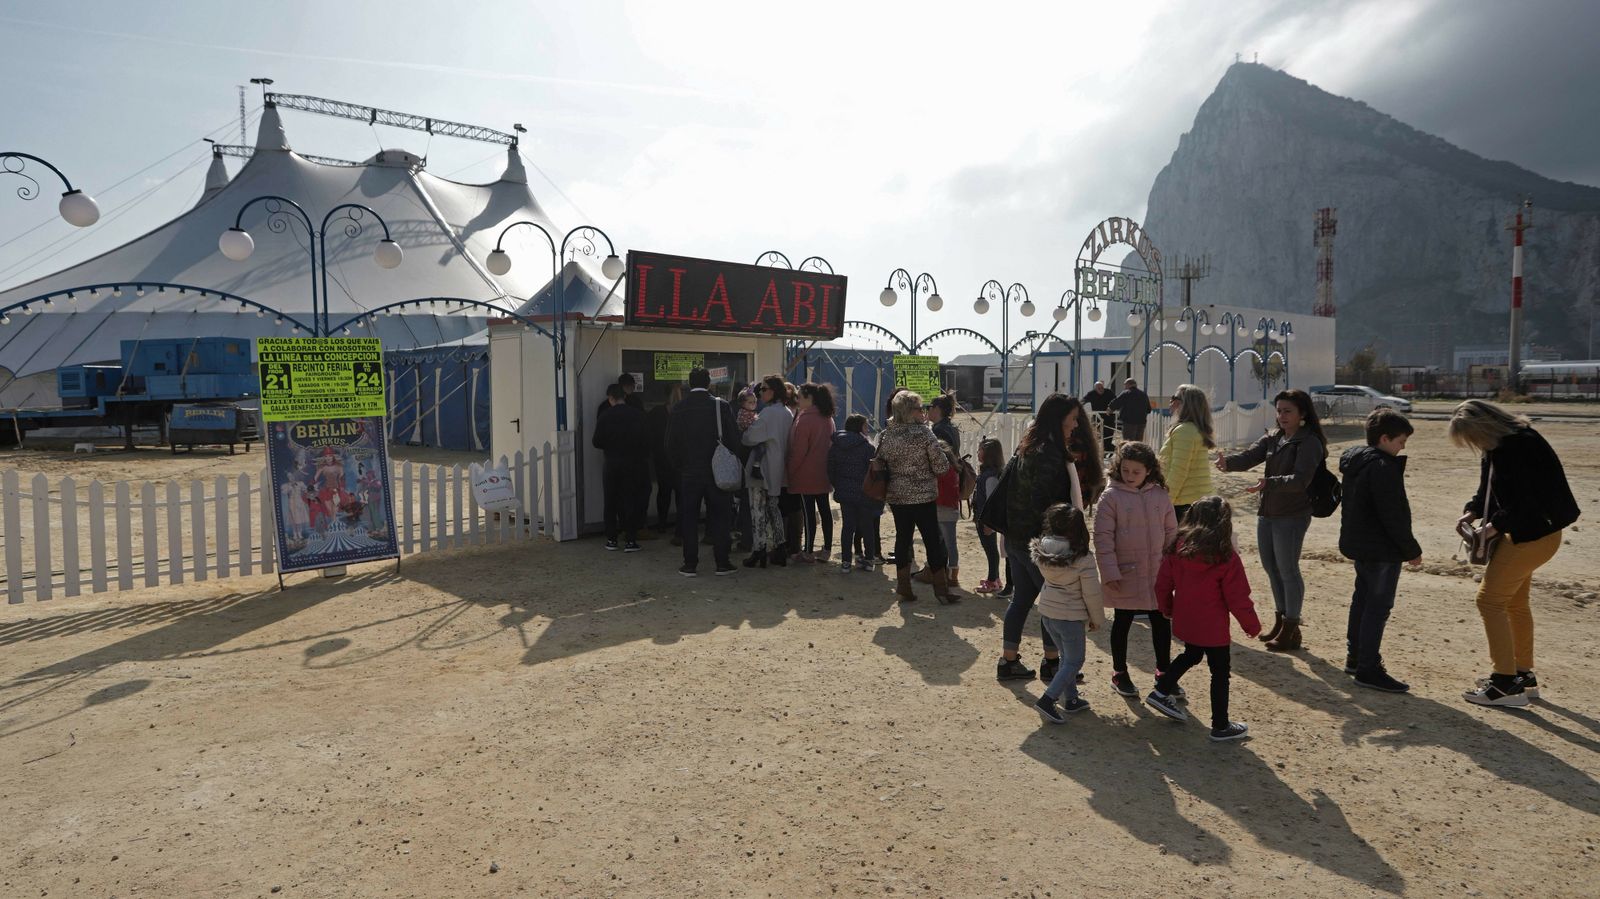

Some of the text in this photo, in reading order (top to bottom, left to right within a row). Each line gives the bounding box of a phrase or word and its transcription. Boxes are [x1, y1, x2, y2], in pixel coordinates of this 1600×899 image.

[1082, 217, 1161, 274] ZIRKUS
[1081, 267, 1160, 305] BERLIN
[635, 265, 833, 329] LLA ABI
[263, 353, 274, 361] LA
[276, 353, 301, 361] LINEA
[324, 352, 378, 361] CONCEPCION
[292, 362, 352, 372] RECINTO FERIAL
[266, 374, 289, 390] 21
[356, 372, 380, 387] 24
[896, 377, 905, 387] 21
[930, 377, 939, 387] 24
[296, 422, 357, 439] BERLIN
[312, 438, 346, 447] ZIRKUS
